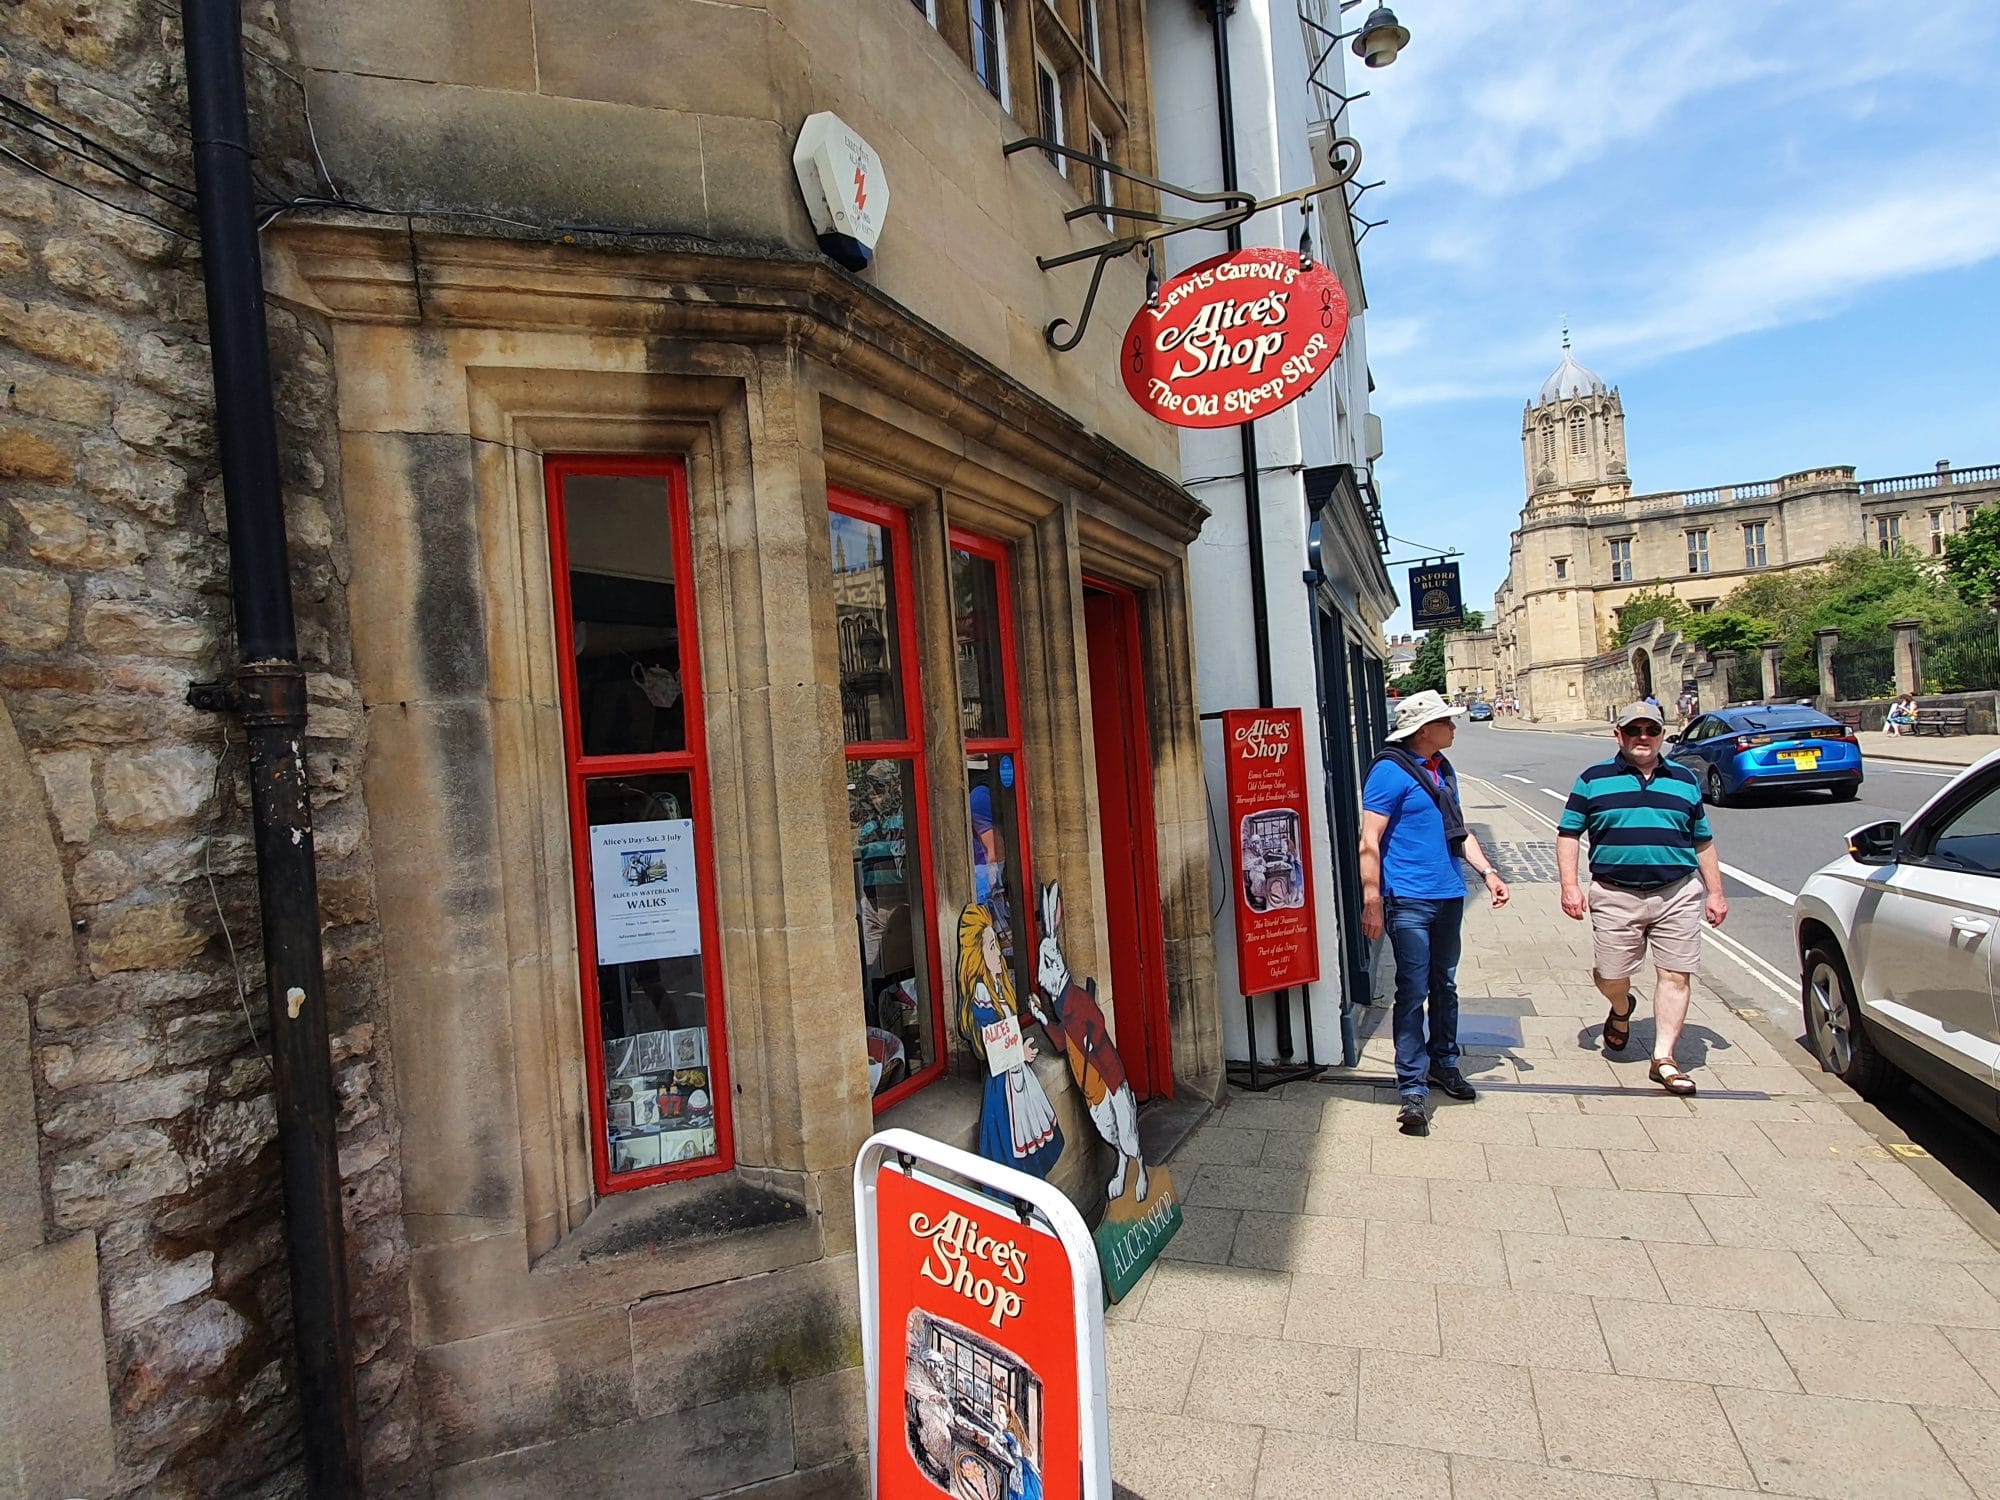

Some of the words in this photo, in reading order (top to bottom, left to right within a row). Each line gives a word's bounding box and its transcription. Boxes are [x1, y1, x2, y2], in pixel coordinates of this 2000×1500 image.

[1147, 268, 1215, 322] Lewis
[1216, 260, 1300, 285] Carroll's
[1155, 290, 1289, 352] Alice's
[1170, 331, 1288, 381] Shop
[1148, 377, 1182, 409] The
[1182, 391, 1219, 416] Old
[1224, 376, 1284, 414] Sheep
[1281, 332, 1329, 384] Shop
[1413, 572, 1456, 584] OXFORD
[1422, 581, 1448, 590] BLUE
[1235, 720, 1290, 741] Alice's
[1242, 734, 1289, 763] Shop
[603, 838, 627, 846] Alice's
[629, 837, 645, 845] Day:
[668, 834, 681, 842] July
[627, 898, 667, 909] WALKS
[640, 888, 680, 896] WATERLAND
[1258, 947, 1269, 956] Part
[1270, 945, 1275, 956] of
[1284, 943, 1298, 953] Story
[909, 1210, 1028, 1284] Alice's
[1112, 1218, 1152, 1281] ALICE'S
[1148, 1191, 1174, 1238] SHOP
[921, 1234, 1026, 1328] Shop
